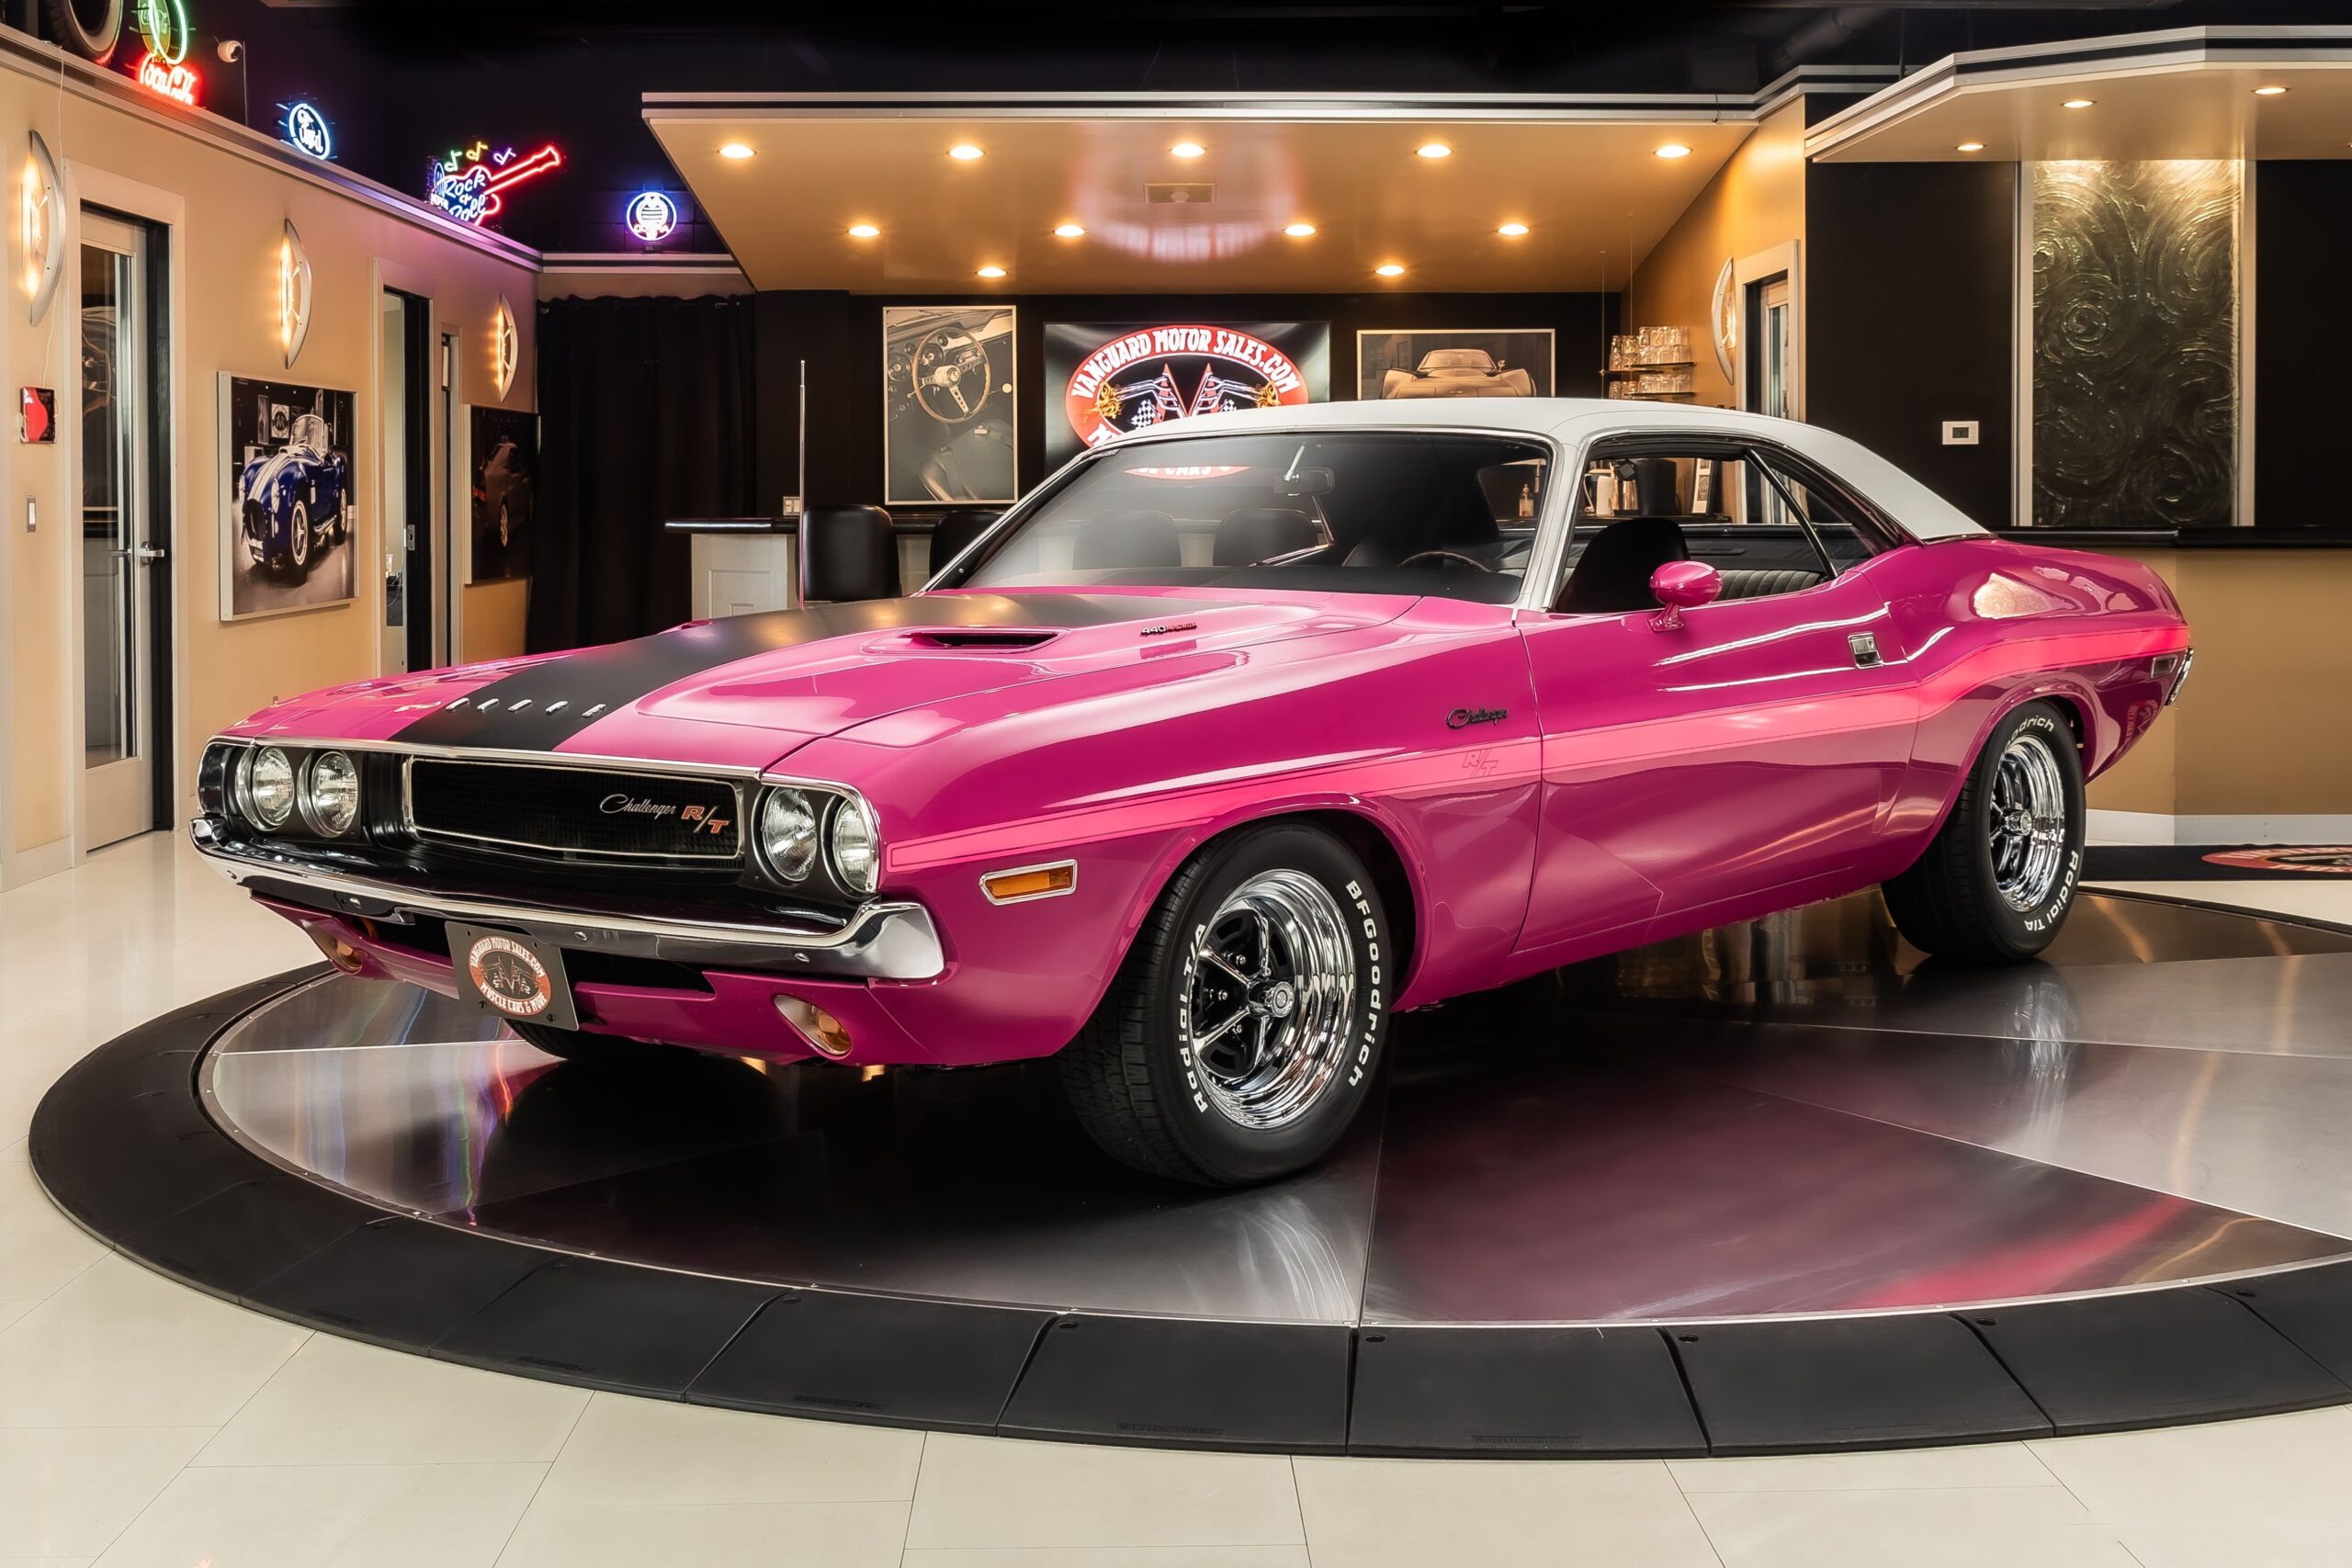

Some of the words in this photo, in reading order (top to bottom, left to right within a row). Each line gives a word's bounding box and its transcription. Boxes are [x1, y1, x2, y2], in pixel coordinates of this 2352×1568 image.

[442, 169, 486, 198] Rock
[1071, 333, 1152, 399] VANGUARD
[1152, 328, 1213, 353] MOTOR
[1213, 331, 1301, 393] SALES.COM
[1446, 707, 1509, 729] Challenger
[1462, 749, 1500, 778] R/T
[599, 793, 677, 820] Challenger
[681, 804, 730, 834] R/T
[2045, 850, 2079, 924] Radial
[2024, 919, 2046, 931] T/A
[491, 937, 511, 952] MOTOR
[1183, 924, 1207, 976] T/A
[480, 982, 507, 1009] MUSCLE
[506, 999, 525, 1014] CARS
[1345, 880, 1382, 1087] BFGoodrich
[1179, 993, 1209, 1113] Radial
